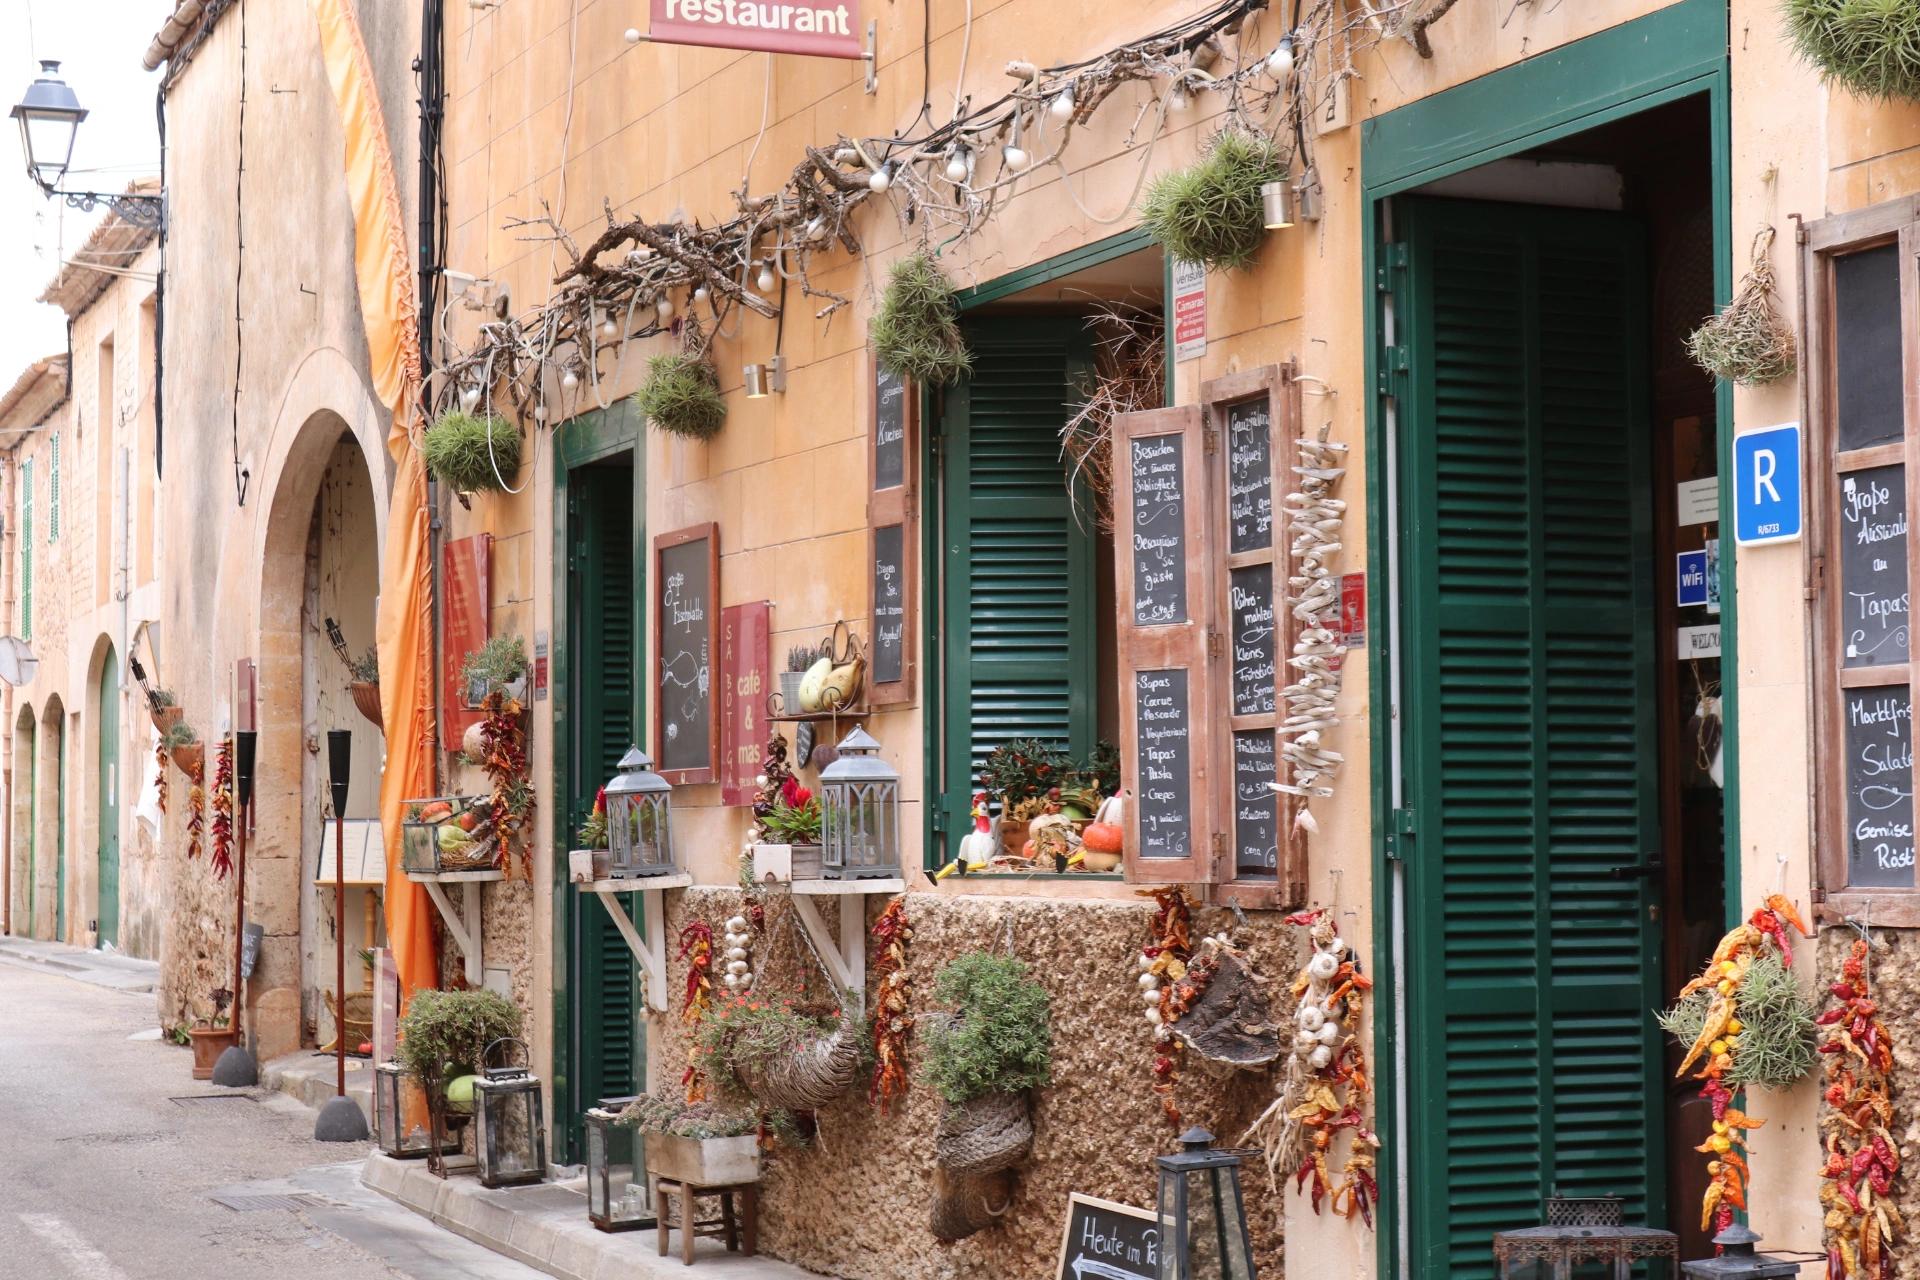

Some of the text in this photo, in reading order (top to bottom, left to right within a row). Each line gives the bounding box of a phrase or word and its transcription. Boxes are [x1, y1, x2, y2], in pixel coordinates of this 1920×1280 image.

[666, 0, 849, 35] restaurant
[1133, 439, 1175, 460] Besuchen
[1133, 461, 1147, 476] Sie
[1754, 449, 1780, 505] R
[1134, 477, 1177, 493] Bibliothek
[1757, 523, 1780, 535] R/6733
[737, 668, 761, 698] café
[1140, 675, 1171, 692] Sopas
[1144, 694, 1173, 707] Carne
[1241, 701, 1258, 714] und
[745, 703, 754, 732] &
[738, 743, 761, 766] mas
[1145, 746, 1176, 764] Tapas
[1146, 766, 1173, 780] Pasta
[1148, 788, 1176, 804] Crepes
[1082, 1216, 1124, 1256] Heute
[1126, 1245, 1141, 1265] im
